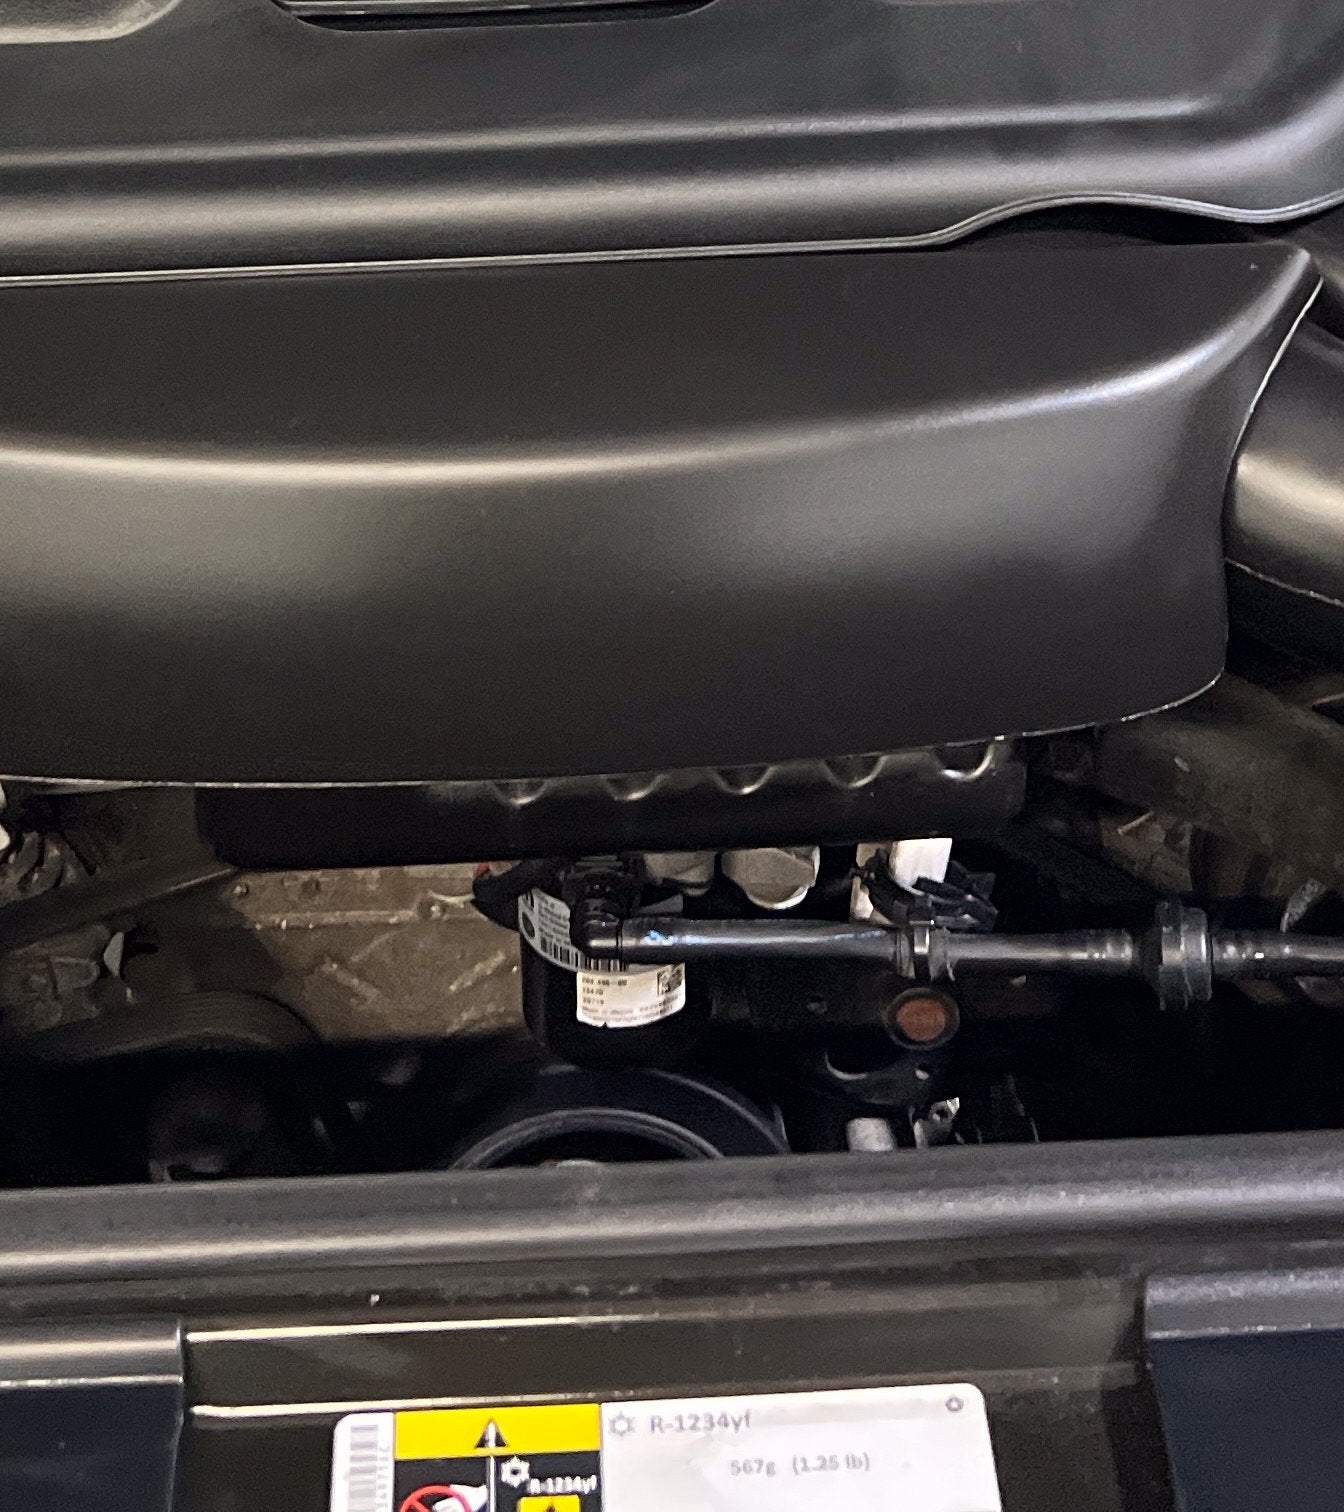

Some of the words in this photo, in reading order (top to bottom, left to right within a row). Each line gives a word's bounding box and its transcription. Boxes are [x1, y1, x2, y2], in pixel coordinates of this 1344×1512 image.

[650, 1408, 752, 1435] R-1234yf
[730, 1457, 776, 1477] 567g
[844, 1451, 871, 1472] lb)
